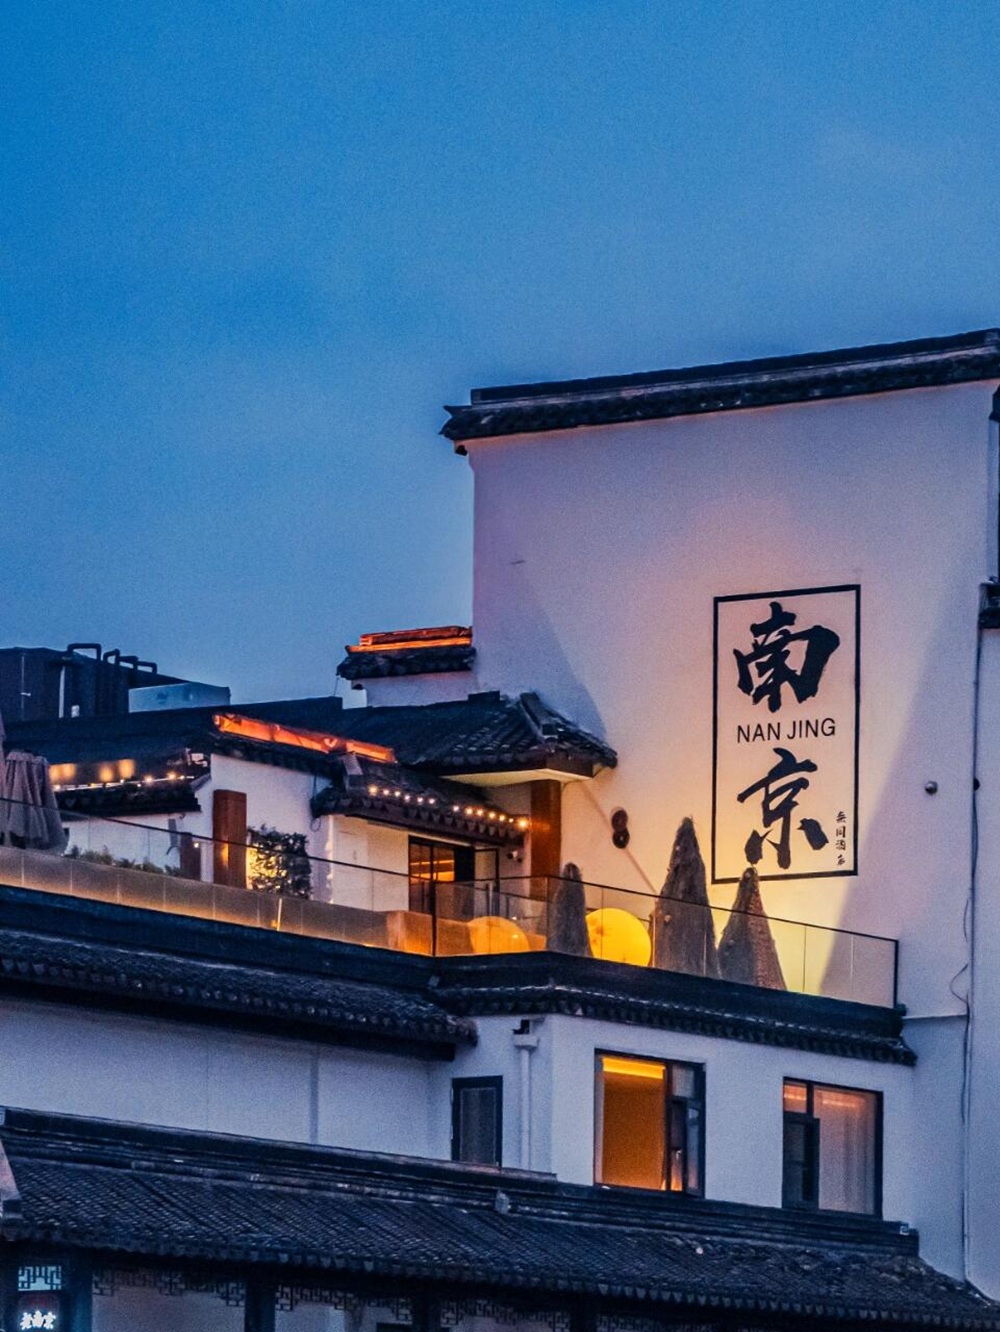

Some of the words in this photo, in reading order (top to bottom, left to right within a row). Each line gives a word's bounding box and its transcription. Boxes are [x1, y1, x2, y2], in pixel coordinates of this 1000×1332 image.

[733, 601, 841, 713] 南
[737, 721, 782, 744] NAN
[786, 717, 836, 740] JING
[737, 747, 829, 869] 京
